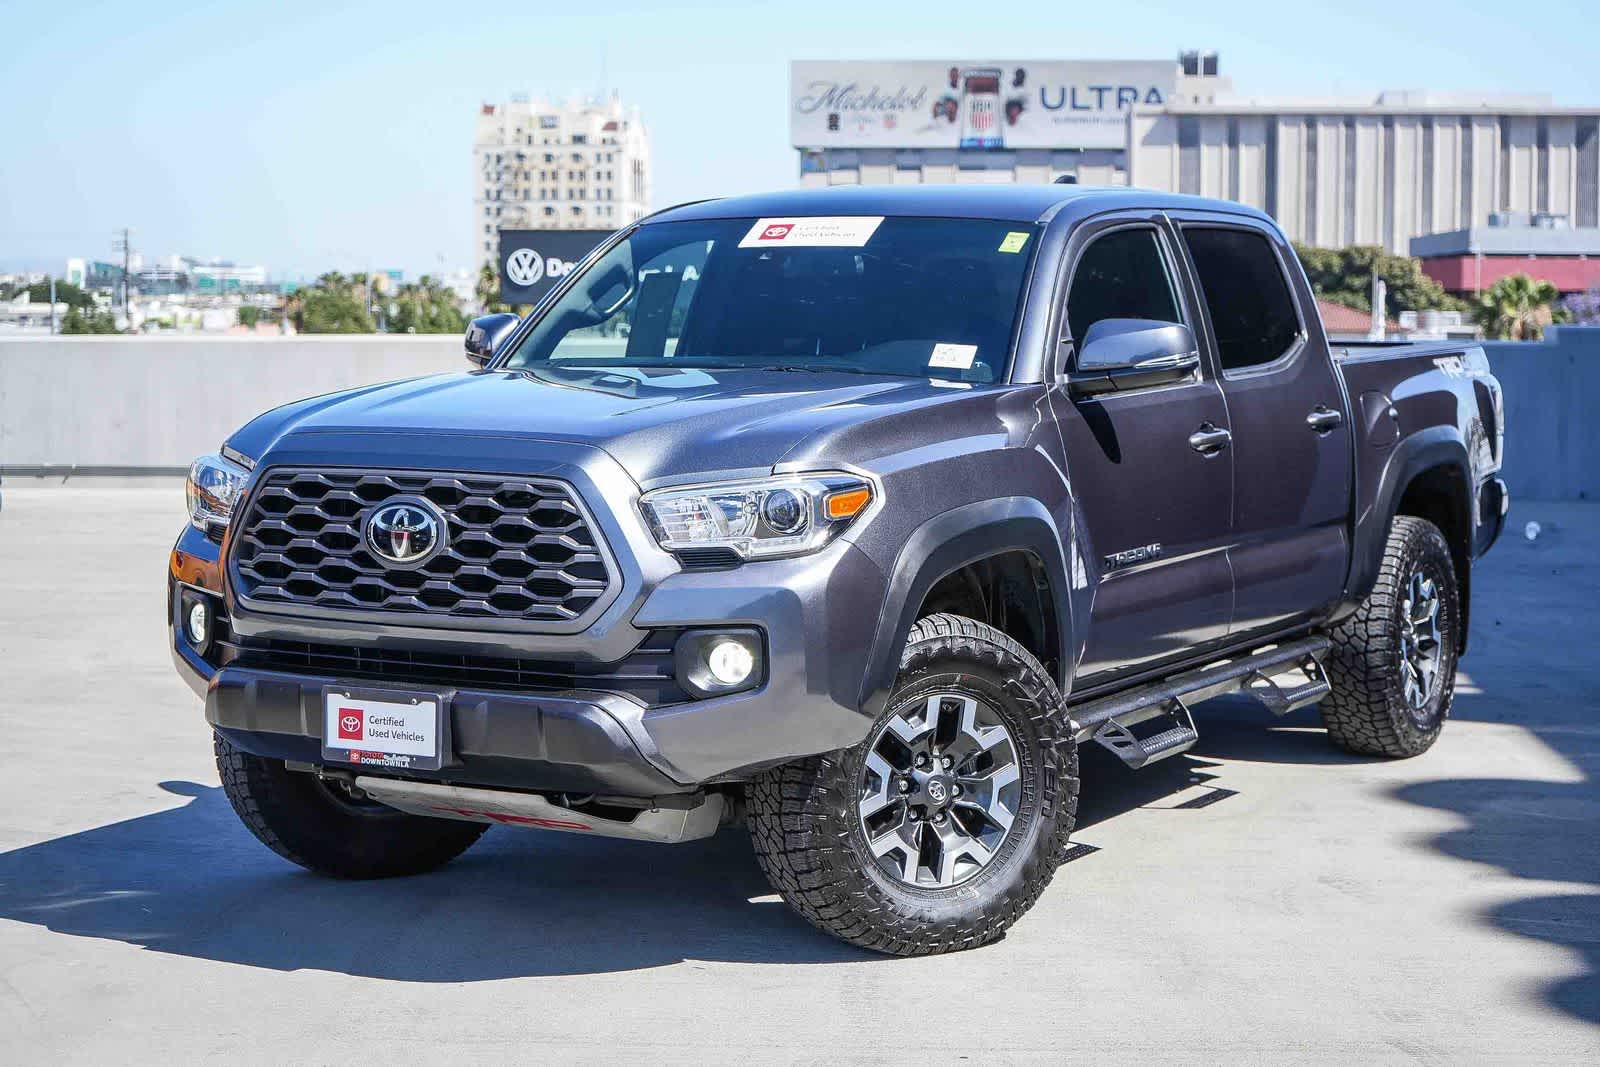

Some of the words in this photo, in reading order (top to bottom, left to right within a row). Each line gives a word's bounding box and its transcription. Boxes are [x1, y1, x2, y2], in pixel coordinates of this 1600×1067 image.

[1041, 86, 1163, 110] ULTRA
[368, 715, 405, 727] Certified
[368, 728, 390, 739] Used
[391, 731, 425, 742] Vehicles
